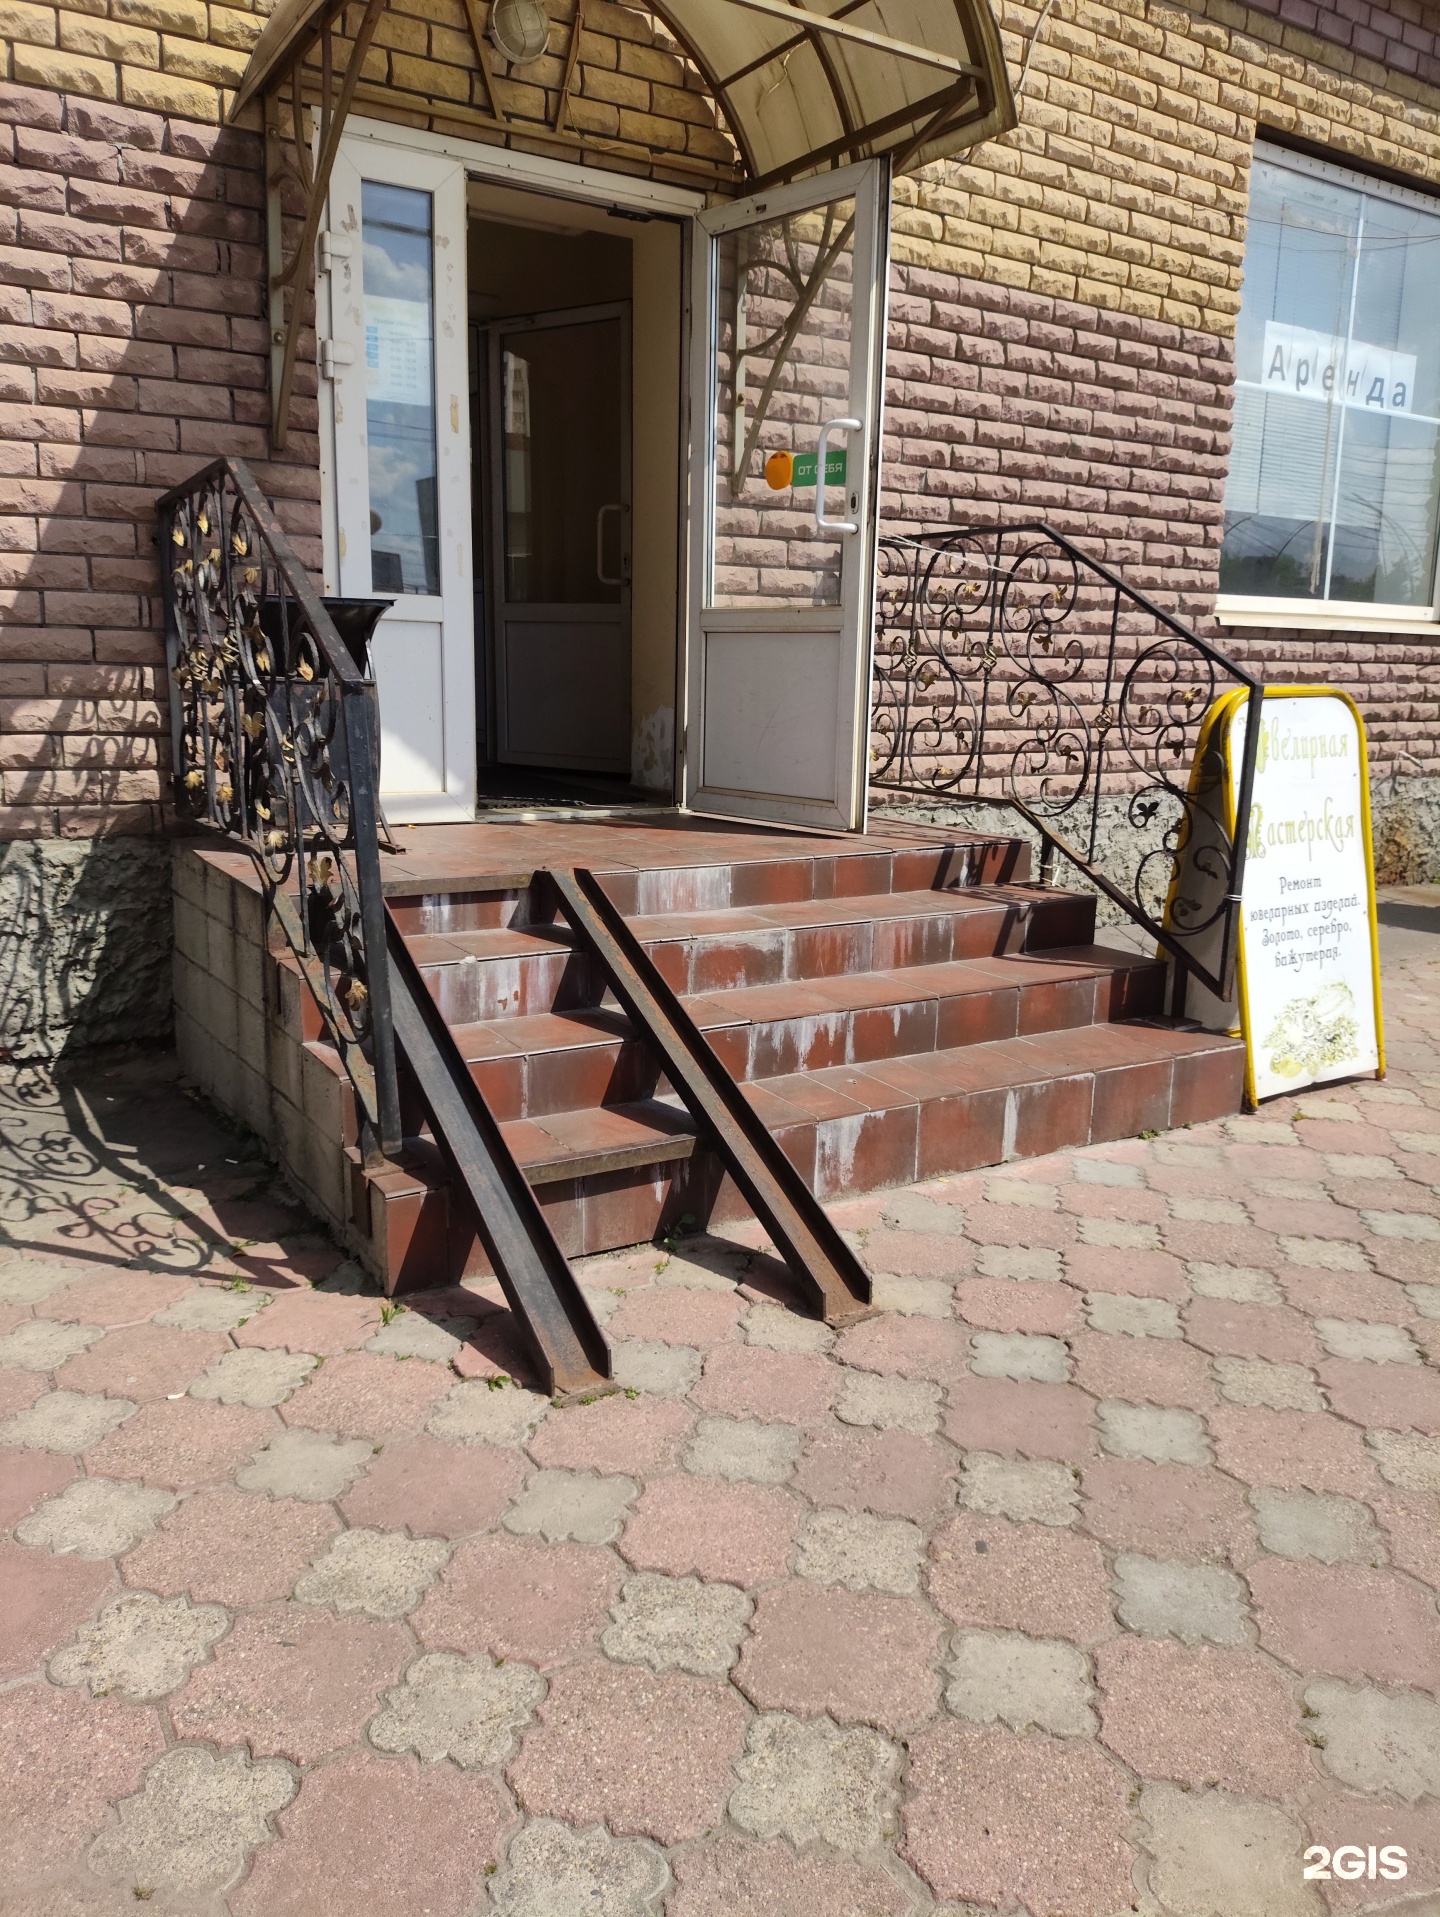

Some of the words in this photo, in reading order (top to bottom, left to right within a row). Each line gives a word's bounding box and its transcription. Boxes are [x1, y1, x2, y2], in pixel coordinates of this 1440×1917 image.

[1267, 344, 1407, 409] Аренда
[798, 465, 812, 476] ОТ
[1279, 876, 1322, 895] Ремонт
[1250, 902, 1310, 927] ювелирных
[1261, 928, 1304, 947] Золото,
[1307, 917, 1352, 946] серебро,
